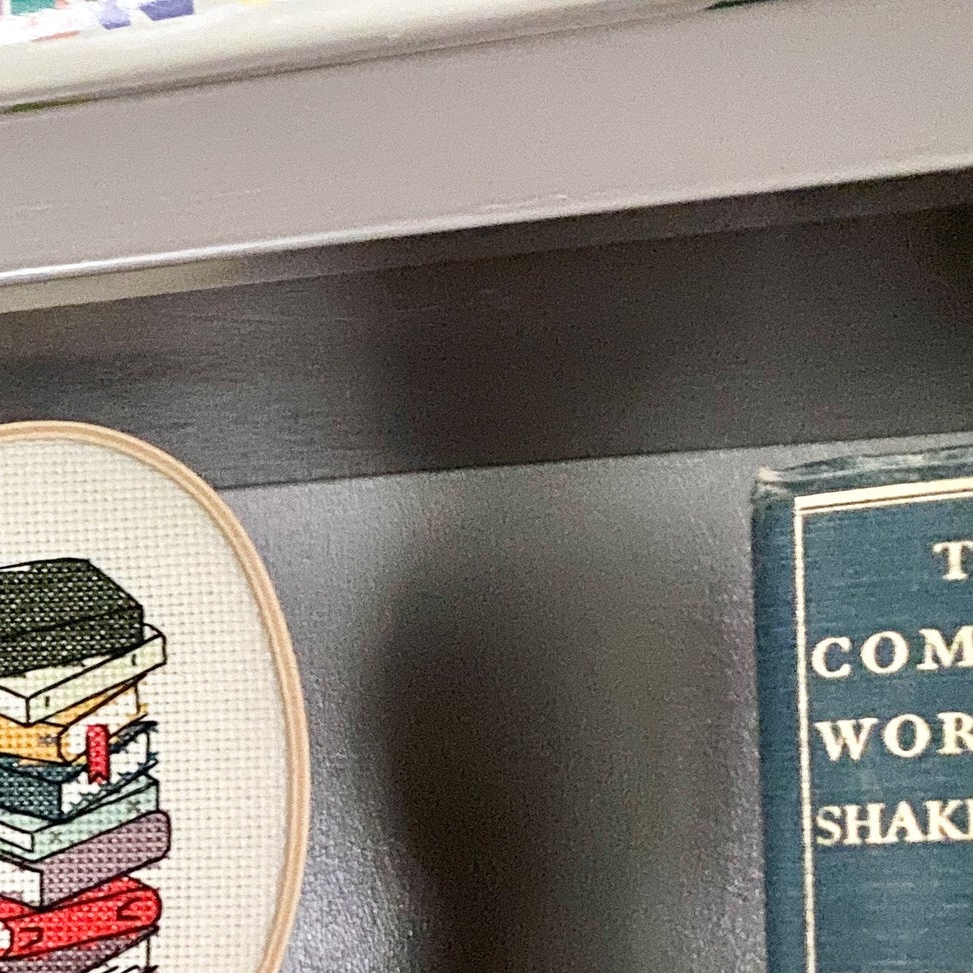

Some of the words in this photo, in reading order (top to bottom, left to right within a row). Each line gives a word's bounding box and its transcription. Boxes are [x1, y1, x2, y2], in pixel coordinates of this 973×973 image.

[810, 624, 973, 680] COM
[813, 711, 973, 762] WOR
[816, 799, 973, 846] SHAK
